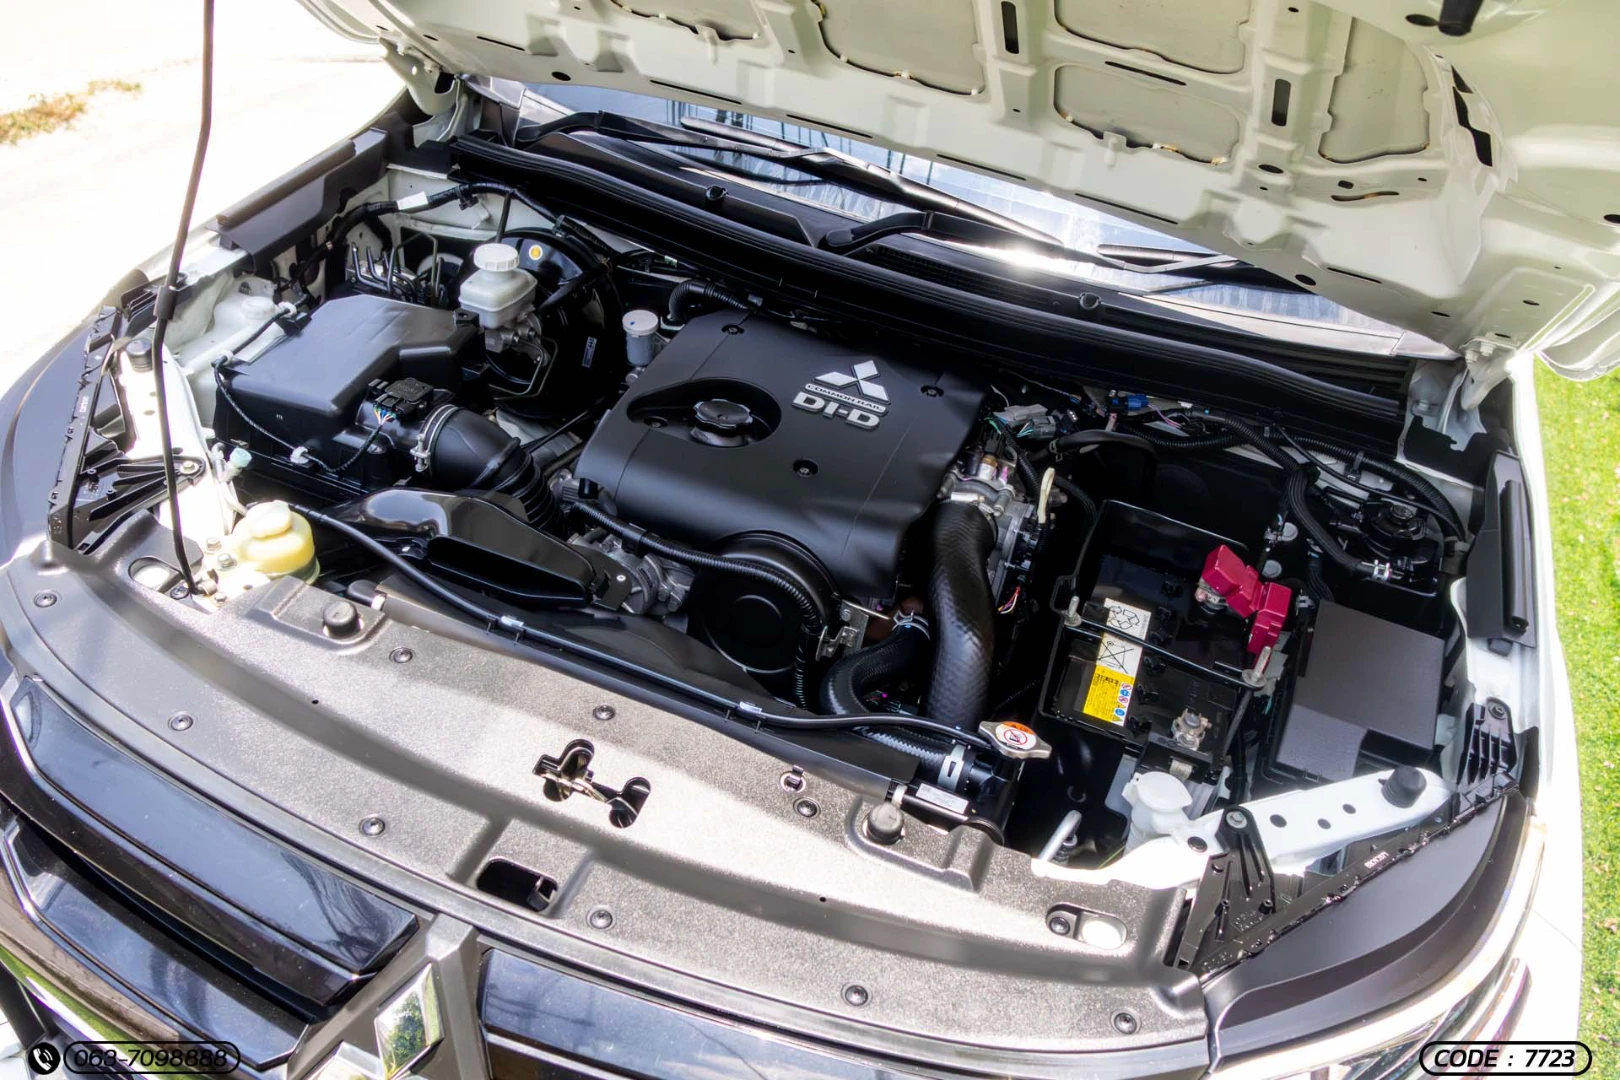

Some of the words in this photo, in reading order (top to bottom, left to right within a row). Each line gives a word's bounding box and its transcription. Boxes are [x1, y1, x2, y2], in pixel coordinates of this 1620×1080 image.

[792, 391, 880, 428] DI-D
[806, 384, 855, 404] COMMON
[856, 400, 883, 411] RAIL
